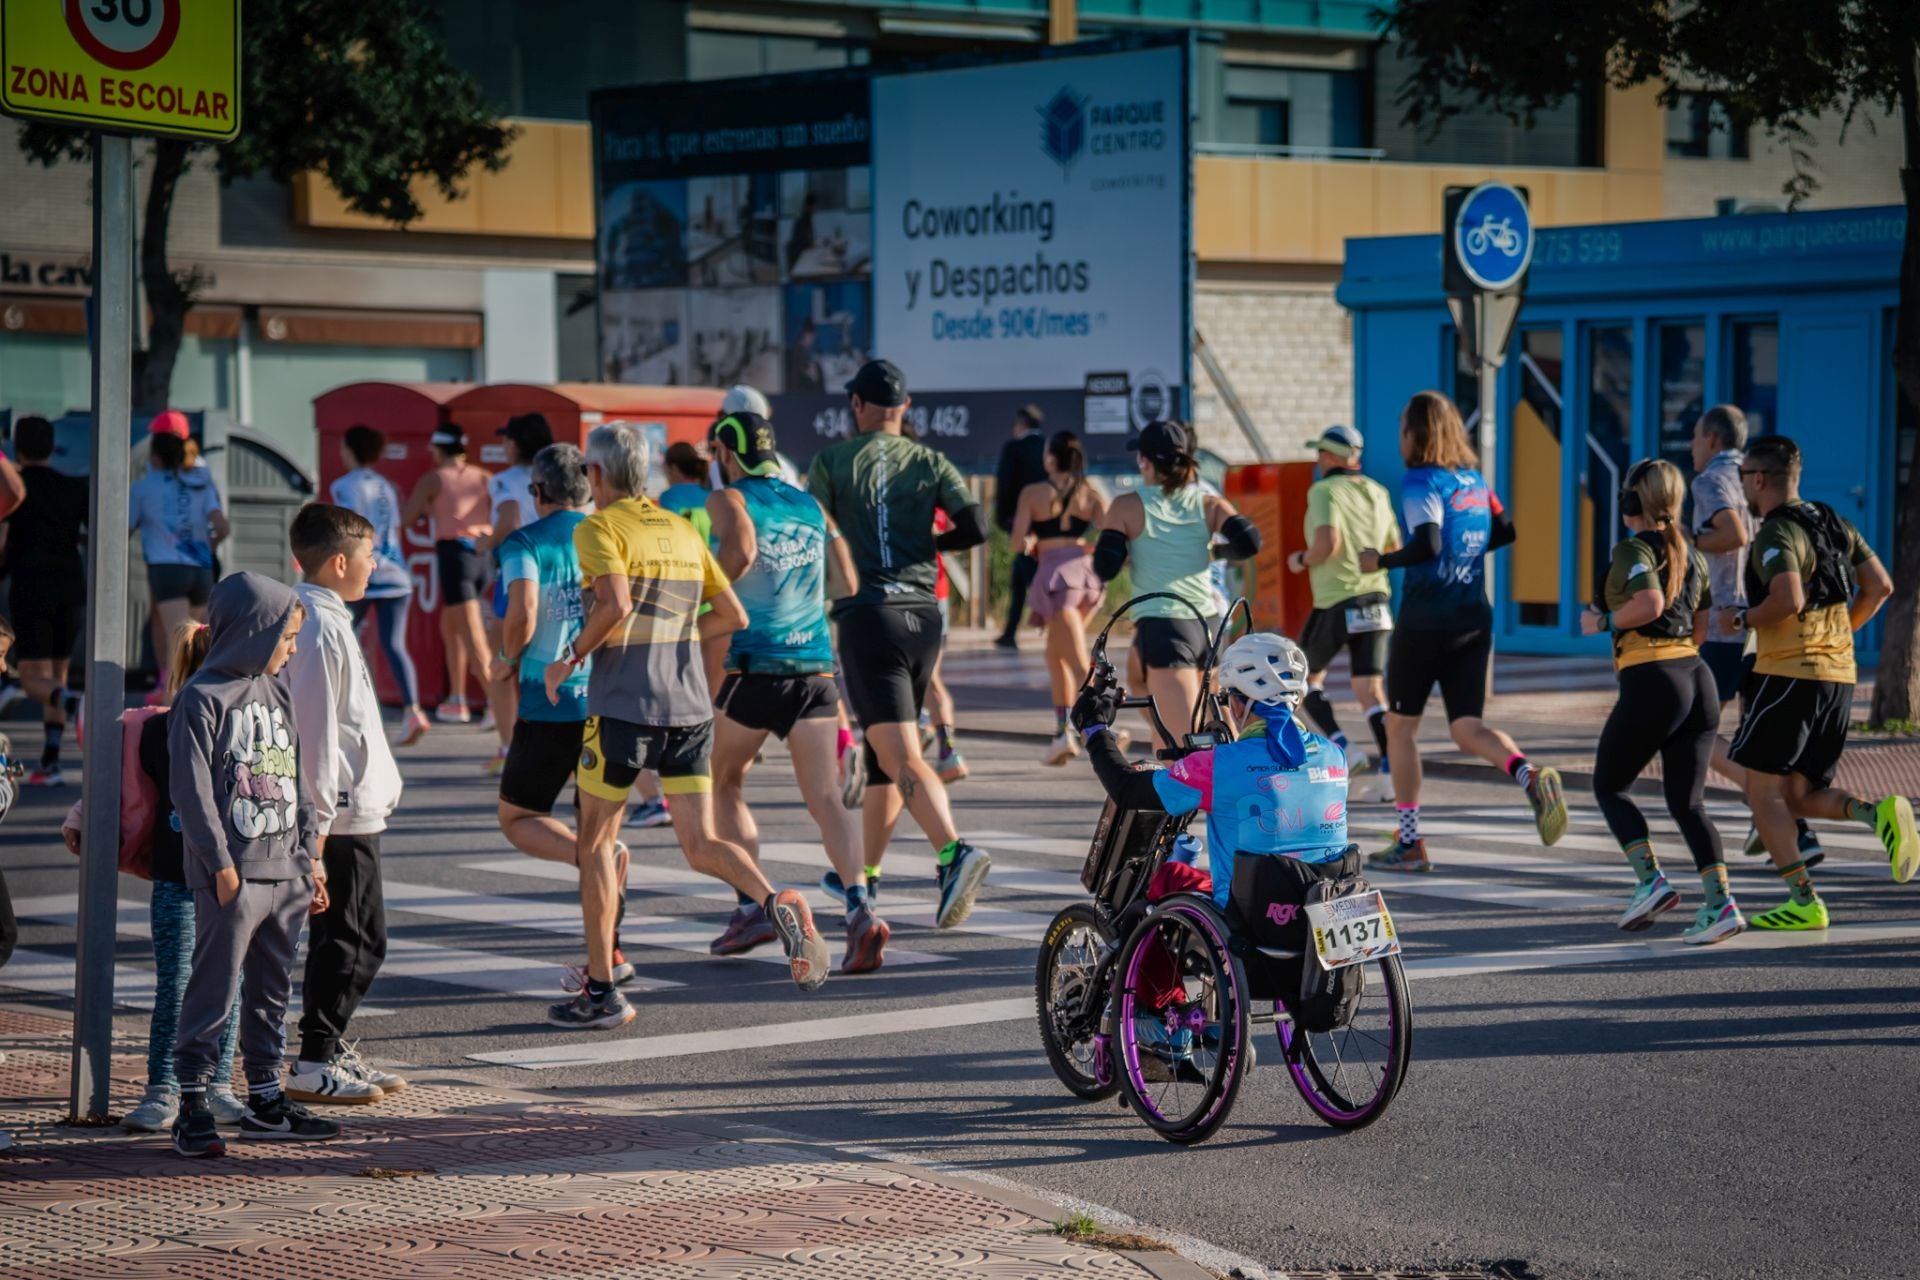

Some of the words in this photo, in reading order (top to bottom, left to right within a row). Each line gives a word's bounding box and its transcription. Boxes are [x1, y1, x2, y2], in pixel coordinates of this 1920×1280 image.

[91, 0, 152, 27] 30
[11, 65, 89, 103] ZONA
[100, 77, 229, 120] ESCOLAR
[1091, 101, 1164, 126] PARQUE
[781, 122, 807, 148] un
[1091, 130, 1165, 155] CENTRO
[903, 191, 1054, 242] Coworking
[1579, 230, 1621, 263] 599
[906, 270, 921, 310] y
[931, 251, 1089, 306] Despachos
[932, 309, 993, 341] Desde
[932, 404, 970, 437] 462
[1266, 903, 1300, 926] RGK
[1325, 918, 1380, 949] 1137
